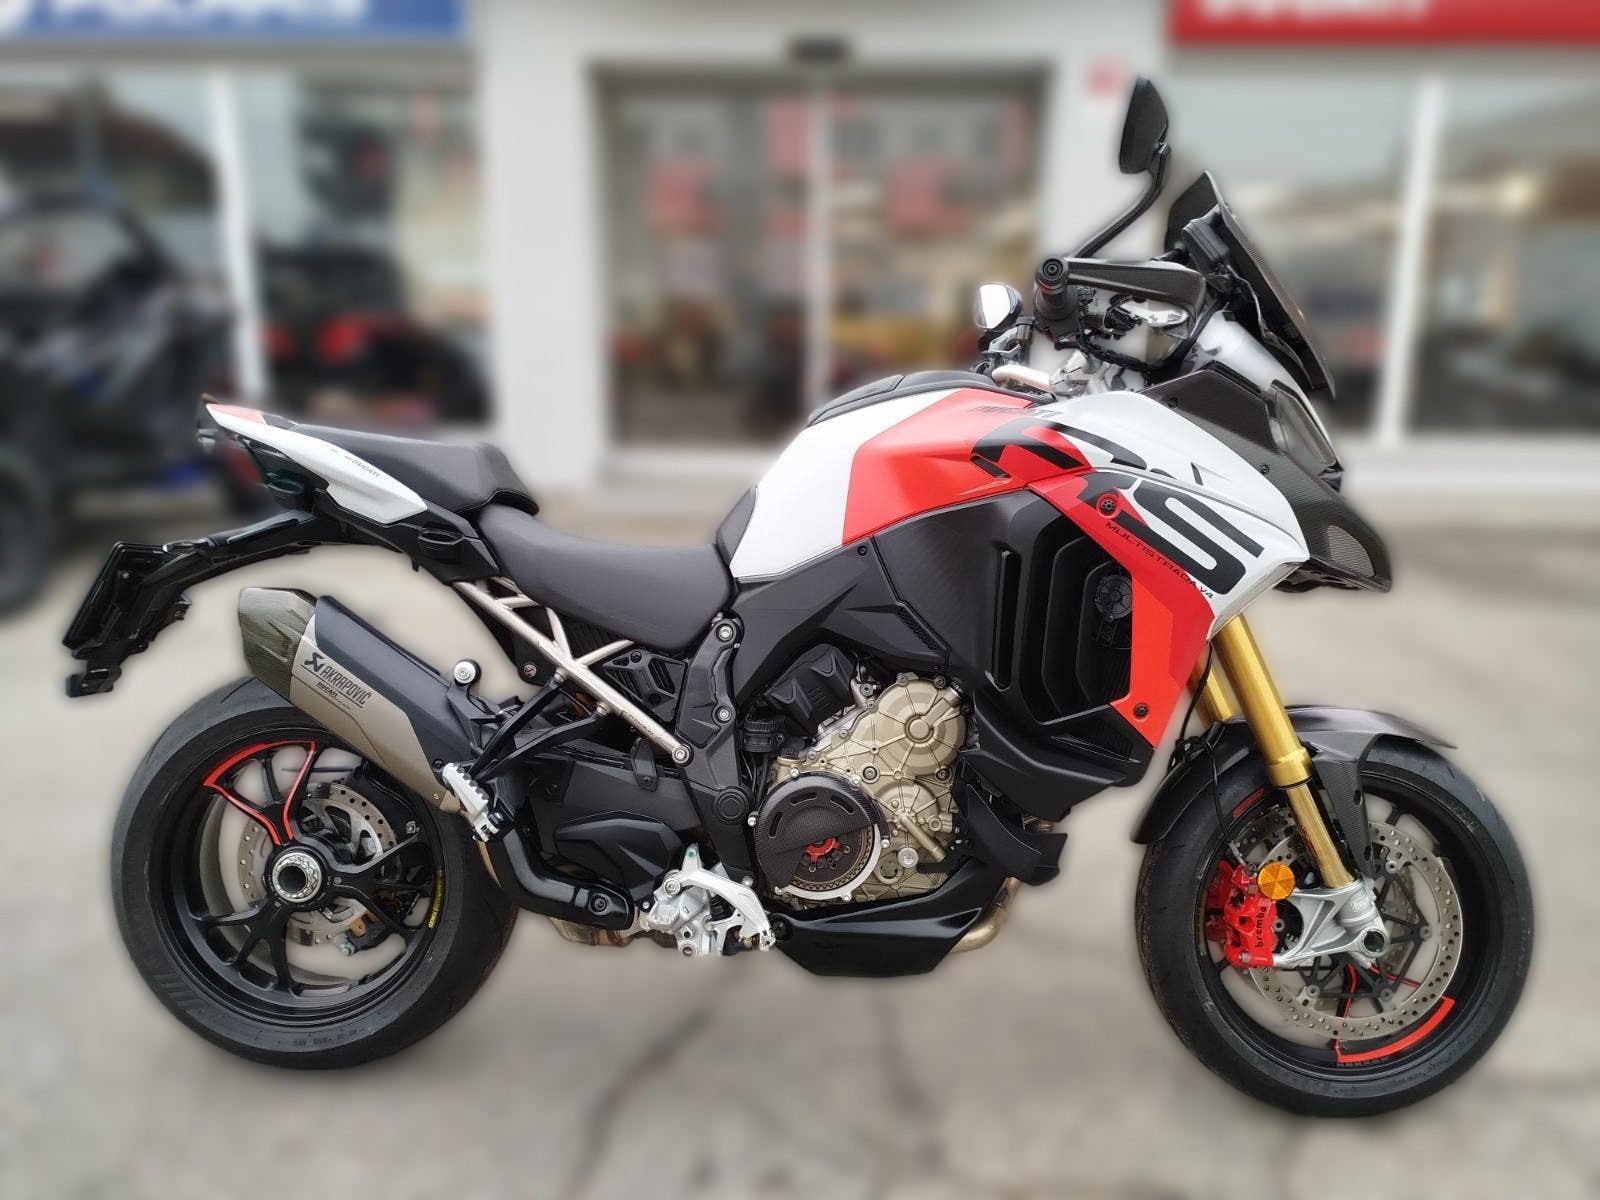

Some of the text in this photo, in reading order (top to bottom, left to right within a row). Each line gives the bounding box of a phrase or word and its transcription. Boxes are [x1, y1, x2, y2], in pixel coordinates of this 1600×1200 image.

[1105, 522, 1214, 599] MULTISTRADA V4
[1255, 906, 1267, 947] brembo
